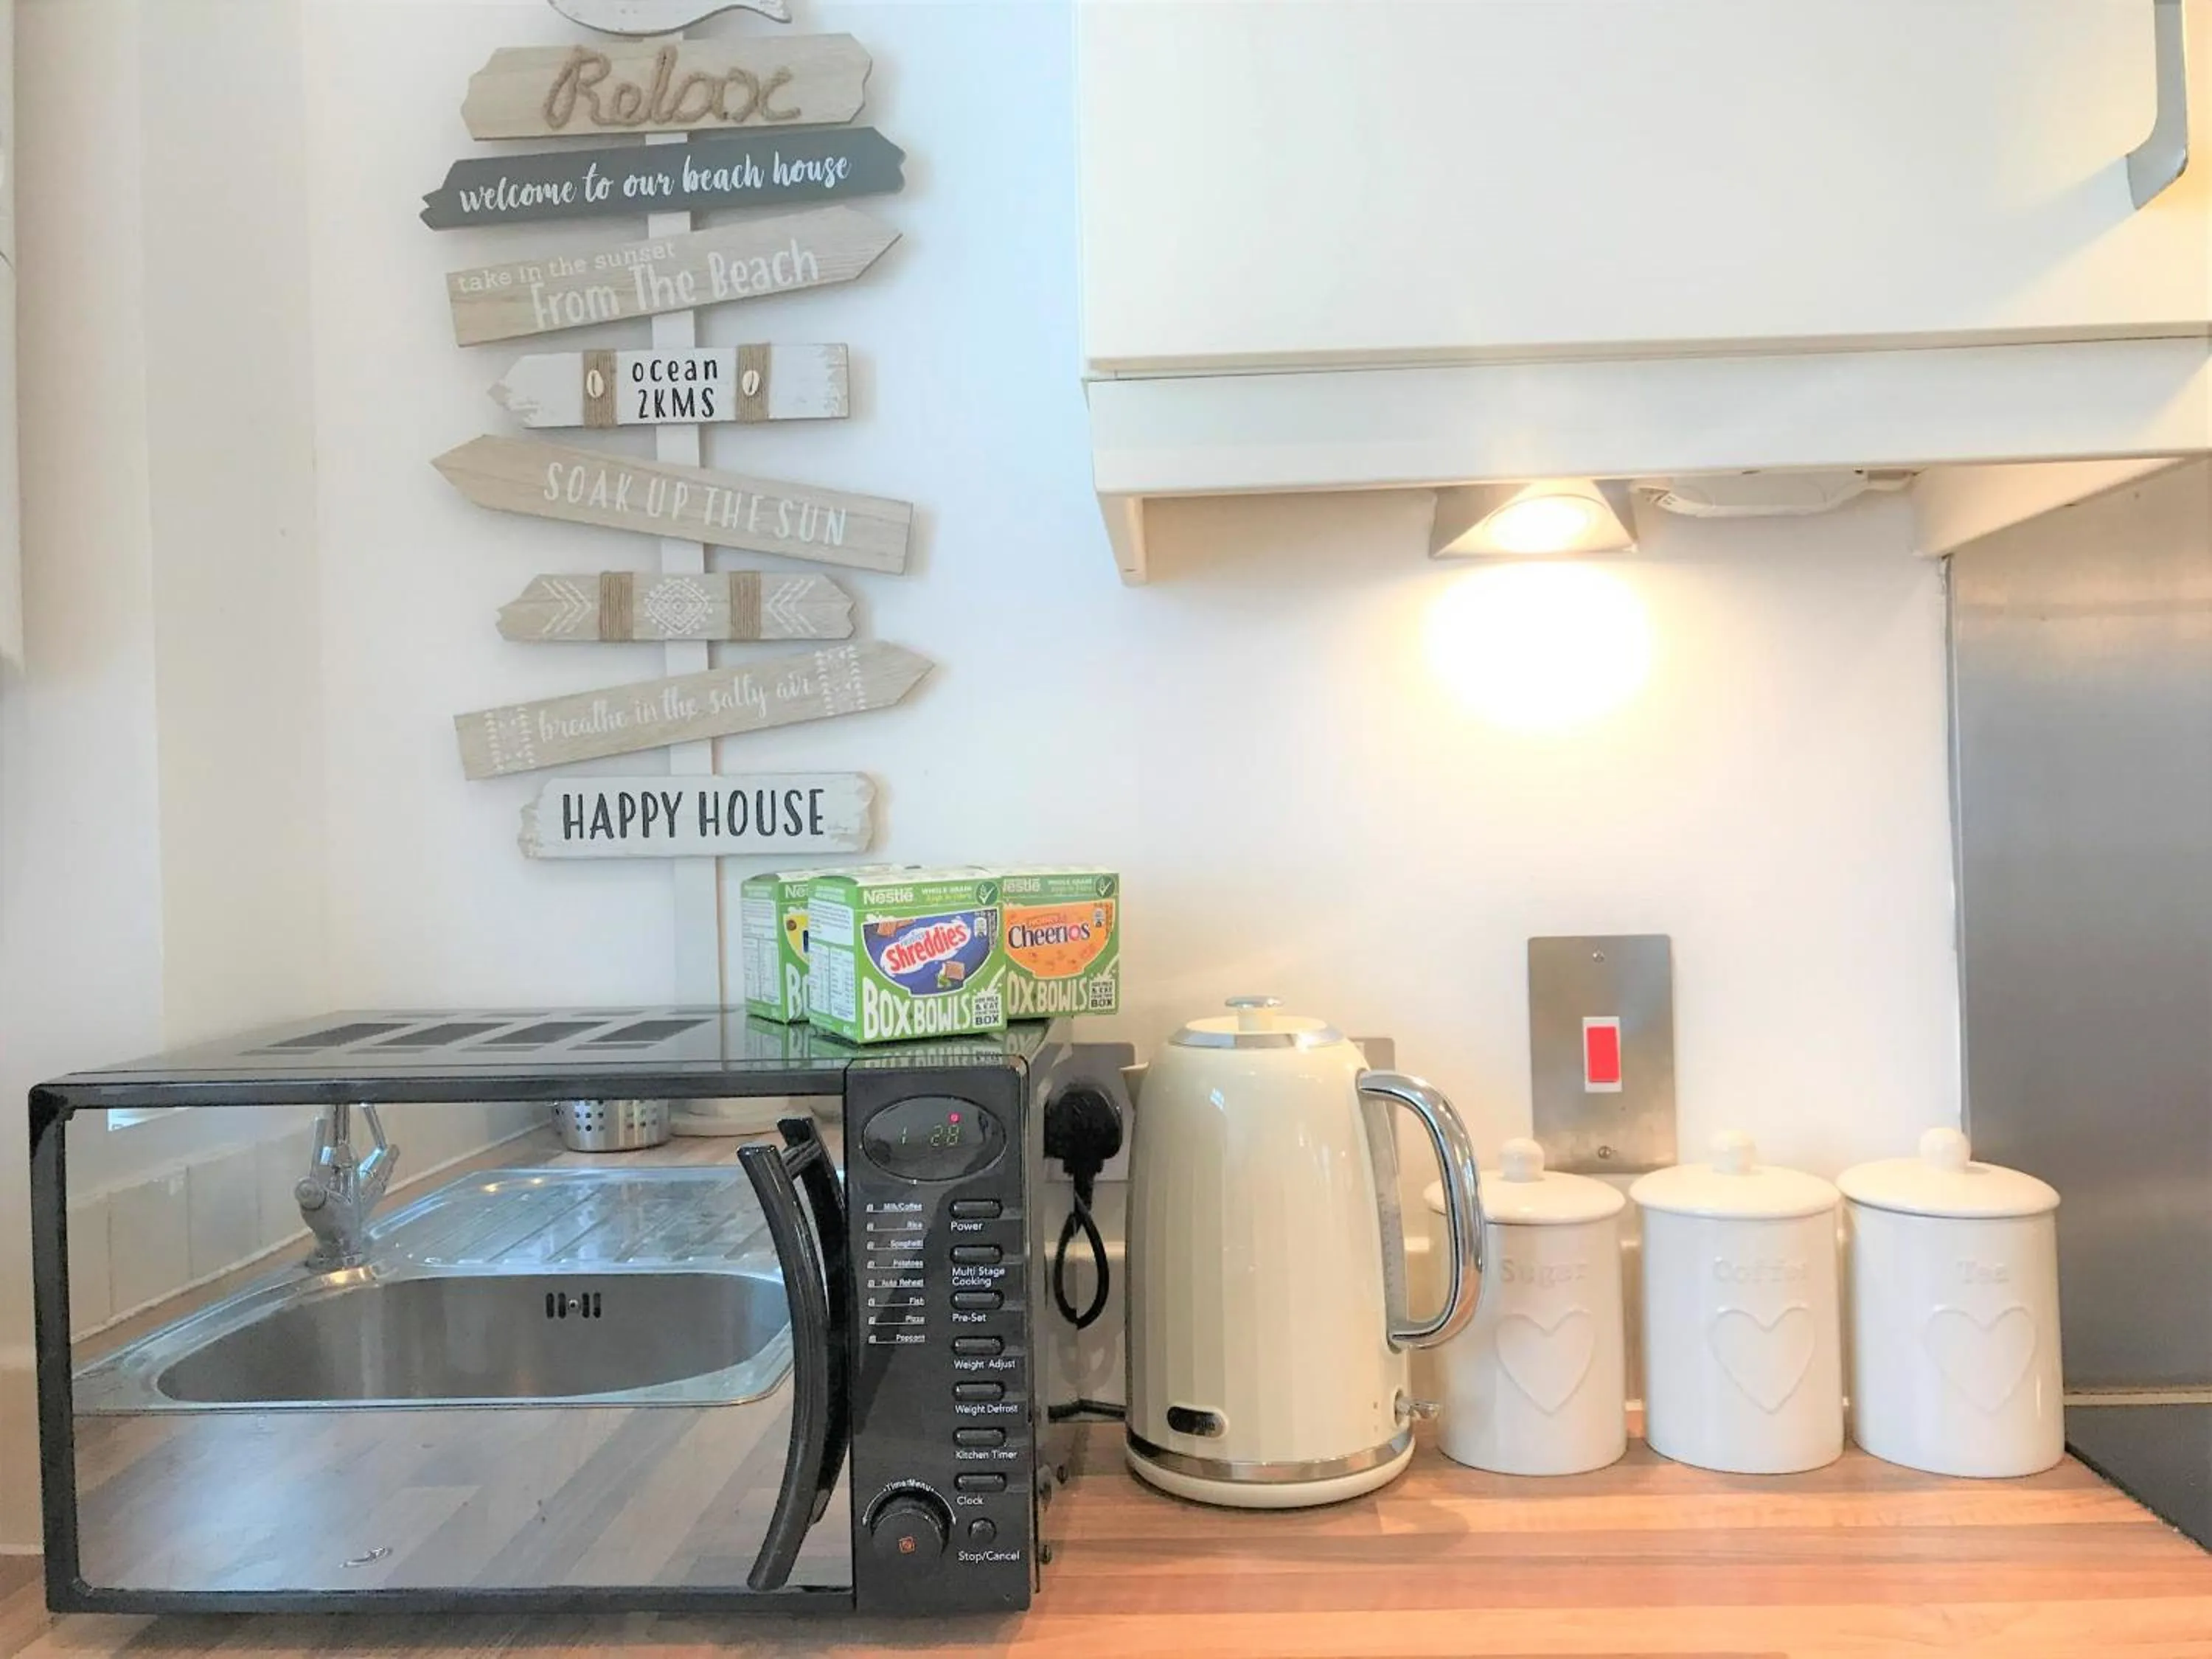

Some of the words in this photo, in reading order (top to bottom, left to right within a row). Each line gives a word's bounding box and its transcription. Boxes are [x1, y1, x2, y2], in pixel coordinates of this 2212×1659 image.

[543, 44, 801, 131] Relax
[459, 177, 577, 212] welcome
[582, 162, 613, 203] to
[623, 170, 674, 197] our
[682, 154, 764, 192] beach
[772, 151, 852, 188] house
[458, 270, 512, 293] take
[519, 265, 543, 283] in
[550, 256, 587, 277] the
[595, 242, 676, 270] sunset
[531, 282, 620, 329] From
[628, 262, 696, 310] The
[707, 237, 820, 299] Beach
[632, 358, 718, 383] ocean
[638, 387, 715, 419] 2KMS
[543, 462, 633, 512] SOAK
[646, 478, 689, 521] UP
[703, 487, 764, 533] THE
[773, 500, 846, 546] SUN
[538, 699, 627, 742] breathe
[635, 700, 658, 724] in
[662, 686, 698, 721] the
[709, 672, 766, 719] salty
[777, 672, 811, 700] air
[563, 790, 683, 841] HAPPY
[699, 788, 825, 838] HOUSE
[885, 923, 969, 973] Shreddies
[1009, 922, 1091, 949] Cheerios
[863, 976, 912, 1040] BOX
[914, 992, 972, 1032] BOWLS
[1037, 978, 1088, 1012] BOWLS
[1091, 999, 1113, 1008] BOX
[975, 1014, 999, 1026] BOX
[950, 1220, 984, 1232] Power
[952, 1267, 976, 1278] Multi
[978, 1266, 1006, 1279] Stage
[952, 1277, 992, 1289] Cooking
[1500, 1258, 1588, 1290] Sugar
[1955, 1259, 2010, 1284] Tea
[952, 1312, 987, 1324] Pre-Set
[954, 1359, 984, 1370] Weight
[989, 1359, 1016, 1370] Adjust
[955, 1404, 986, 1416] Weight
[987, 1404, 1018, 1413] Defrost
[956, 1449, 989, 1459] Kitchen
[992, 1449, 1018, 1459] Timer
[957, 1495, 984, 1506] Clock
[959, 1551, 1020, 1562] Stop/Cancel
